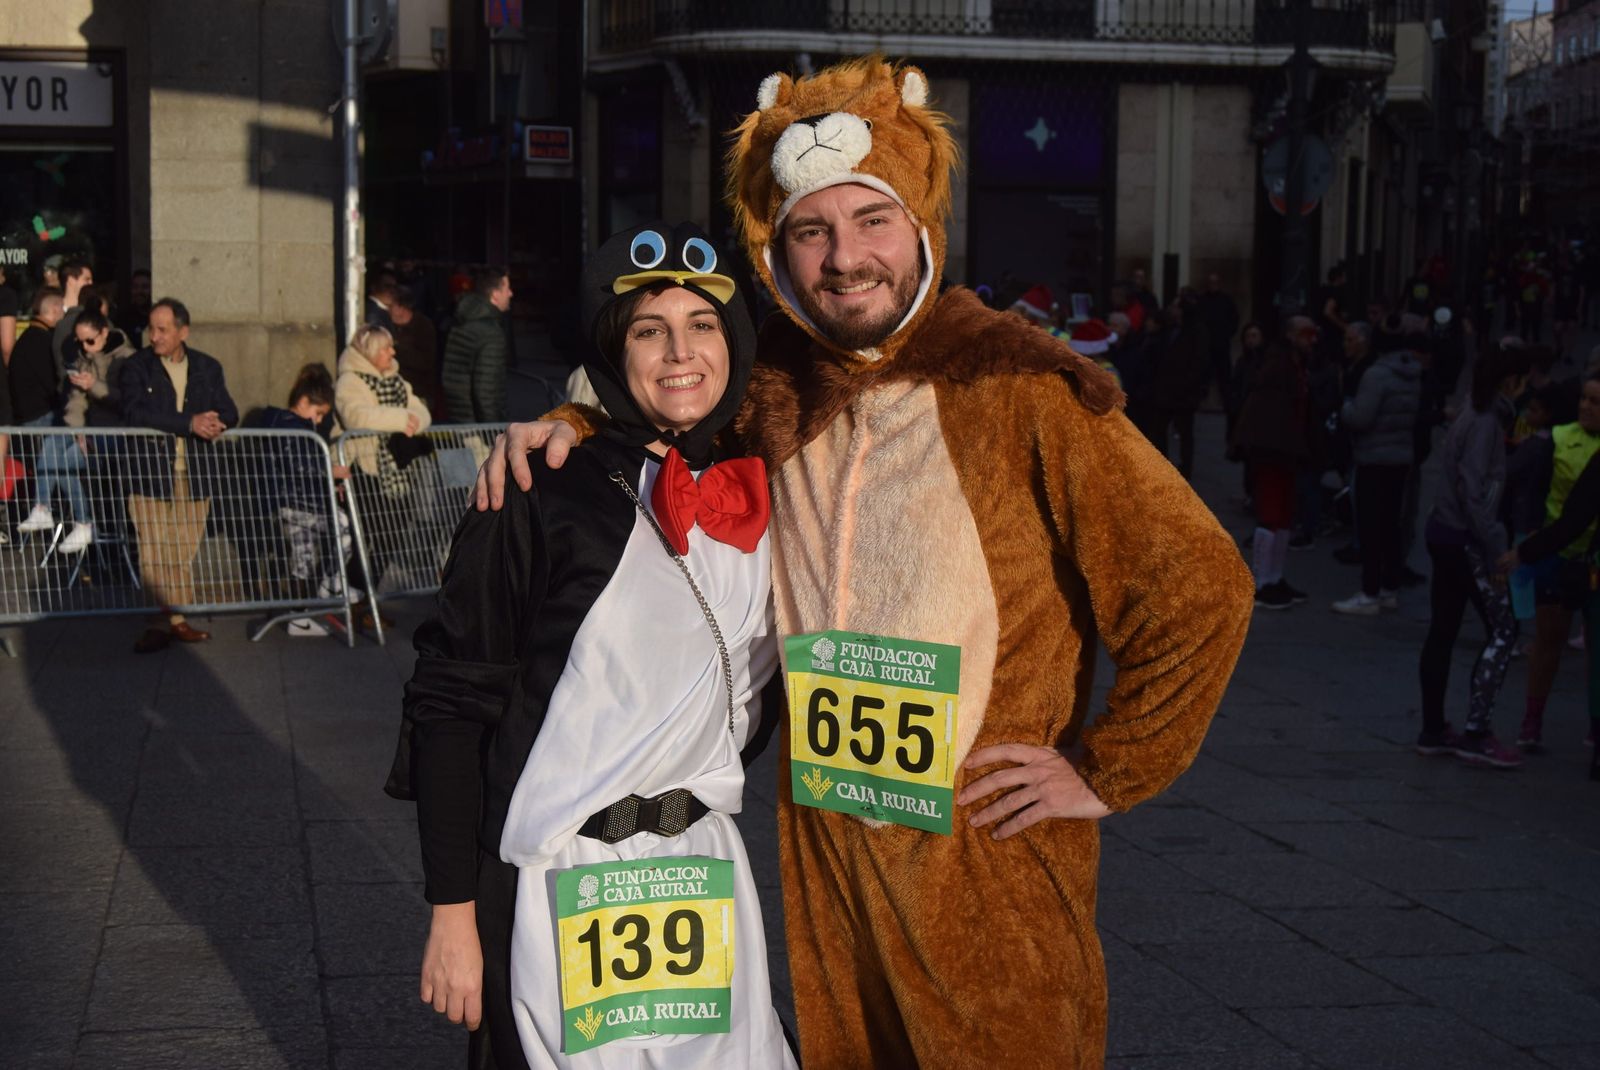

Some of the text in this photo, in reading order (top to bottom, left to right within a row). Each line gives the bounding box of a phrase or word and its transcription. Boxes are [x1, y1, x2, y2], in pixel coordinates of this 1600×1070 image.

[1, 76, 69, 111] YOR
[840, 642, 937, 670] FUNDACION
[839, 659, 935, 686] CAJA RURAL
[807, 687, 935, 774] 655
[836, 782, 942, 819] CAJA RURAL
[603, 866, 709, 886] FUNDACION
[603, 881, 708, 903] CAJA RURAL
[577, 909, 705, 988] 139
[606, 1002, 721, 1026] CAJA RURAL
